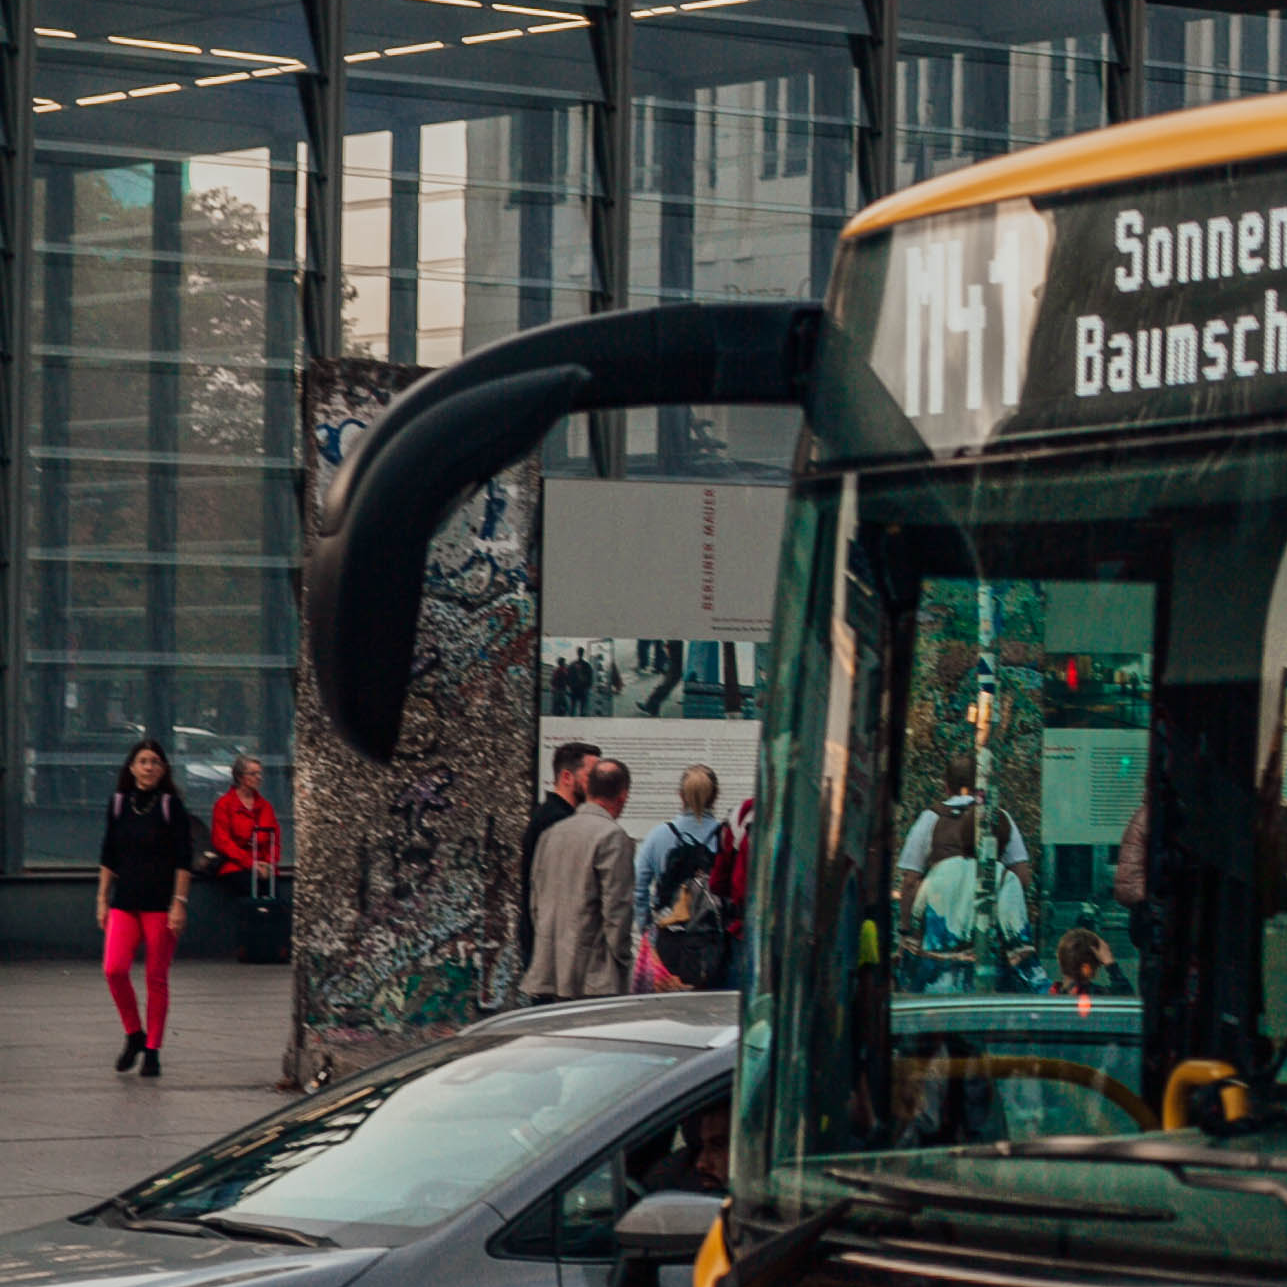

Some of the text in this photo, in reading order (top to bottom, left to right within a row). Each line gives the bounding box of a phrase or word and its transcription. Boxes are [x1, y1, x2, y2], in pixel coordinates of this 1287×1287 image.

[905, 230, 1022, 418] M41
[702, 489, 716, 611] BERLINER MAUER
